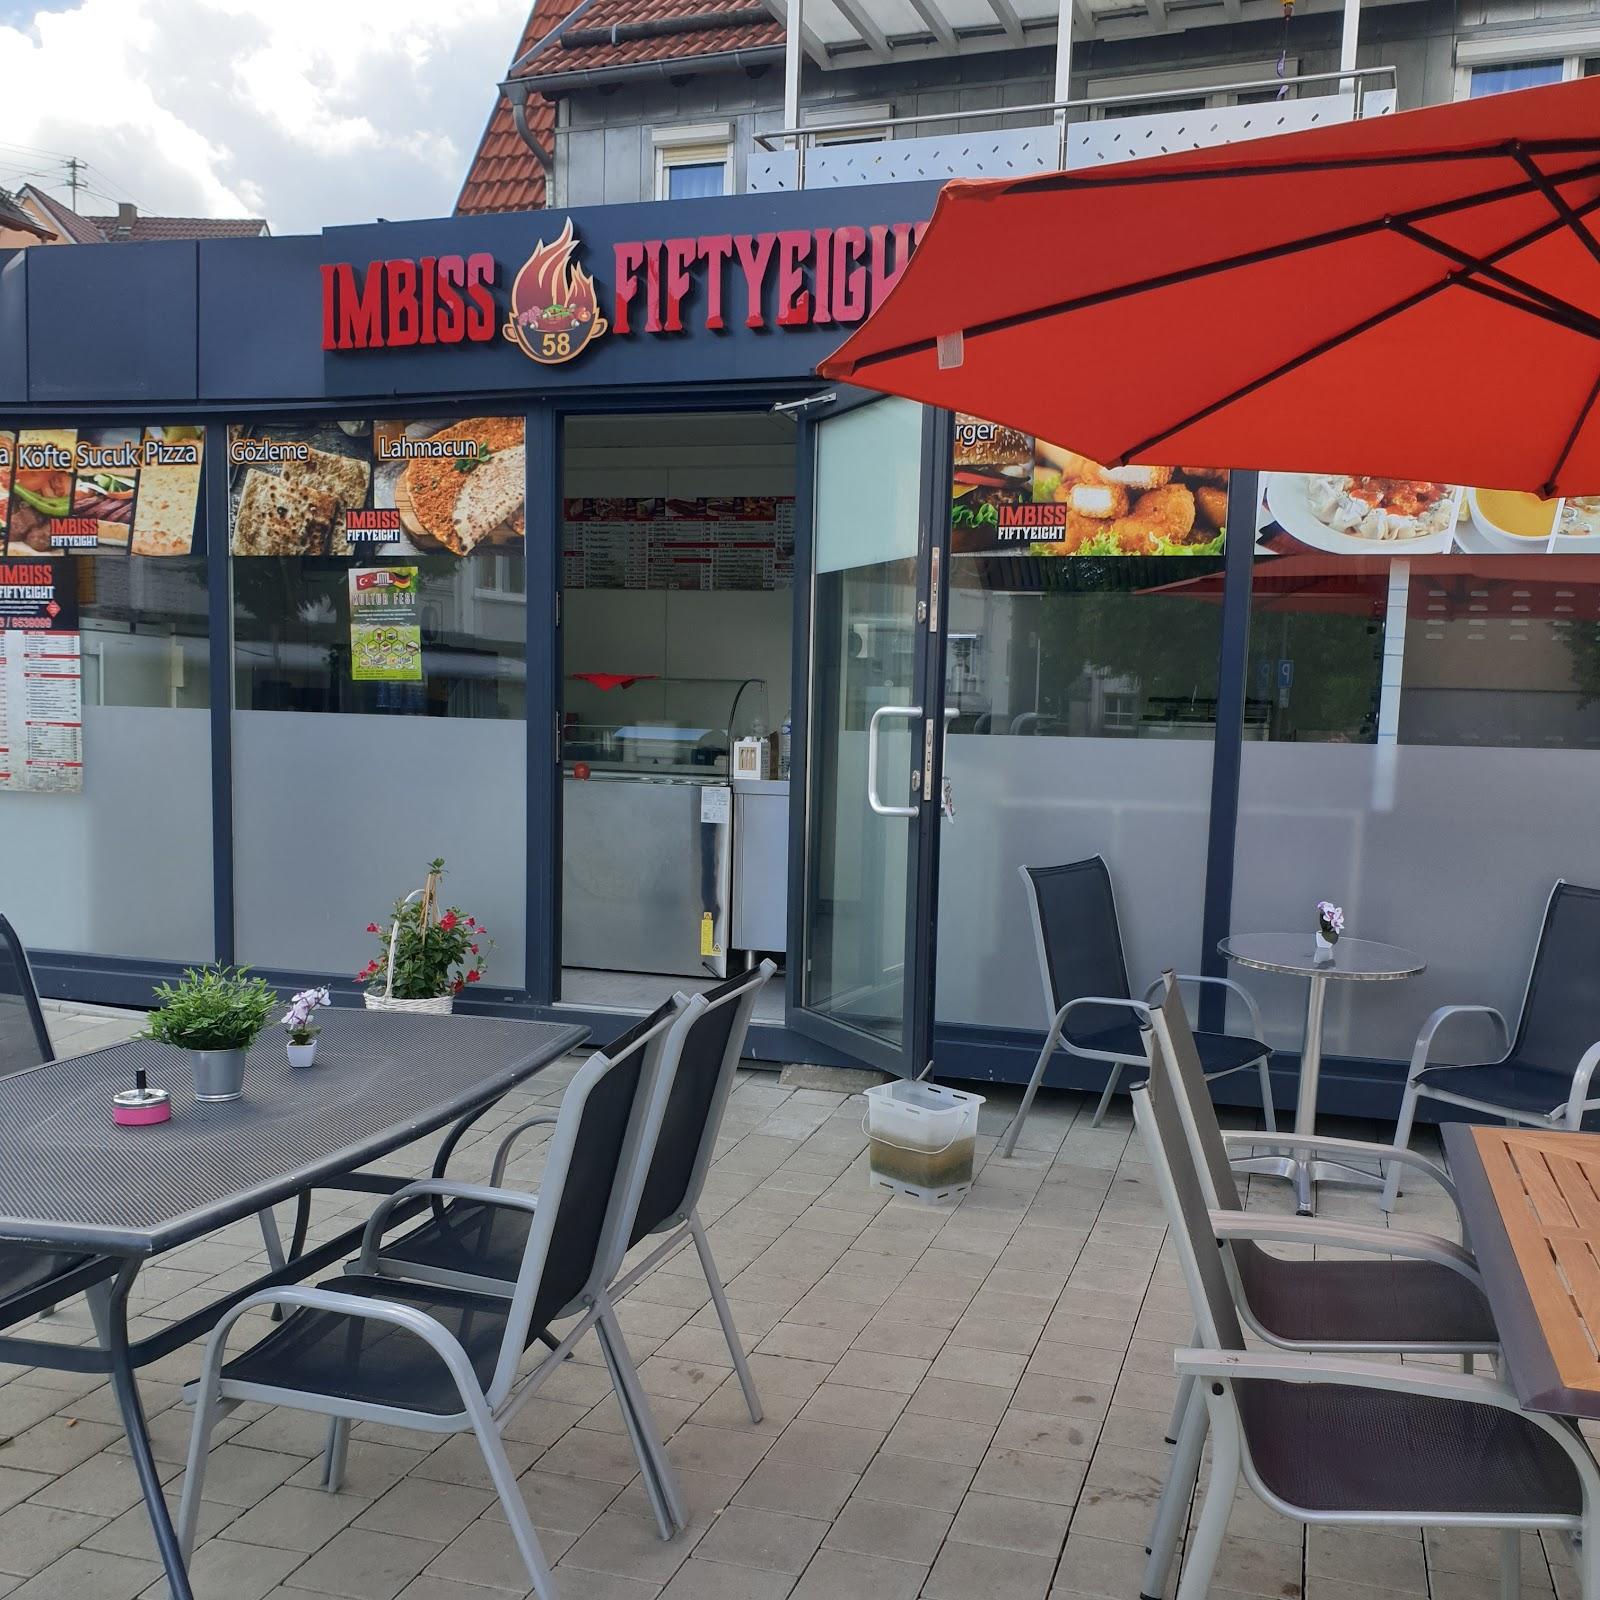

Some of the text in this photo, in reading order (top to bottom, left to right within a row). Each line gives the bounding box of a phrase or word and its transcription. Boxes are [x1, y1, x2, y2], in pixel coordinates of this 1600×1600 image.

[320, 222, 930, 350] IMBISS FIFTYEIGH
[542, 333, 570, 356] 58
[19, 444, 71, 468] Köfte
[77, 443, 138, 467] Sucuk
[145, 441, 197, 464] Pizza
[231, 441, 308, 462] Gözleme
[380, 437, 477, 458] Lahmacun
[51, 518, 97, 535] IMBISS
[347, 511, 399, 529] IMBISS
[1000, 505, 1066, 527] IMBISS
[51, 535, 97, 547] FIFTYEIGHT
[347, 530, 399, 541] FIFTYEIGHT
[998, 527, 1065, 540] FIFTYEIGHT
